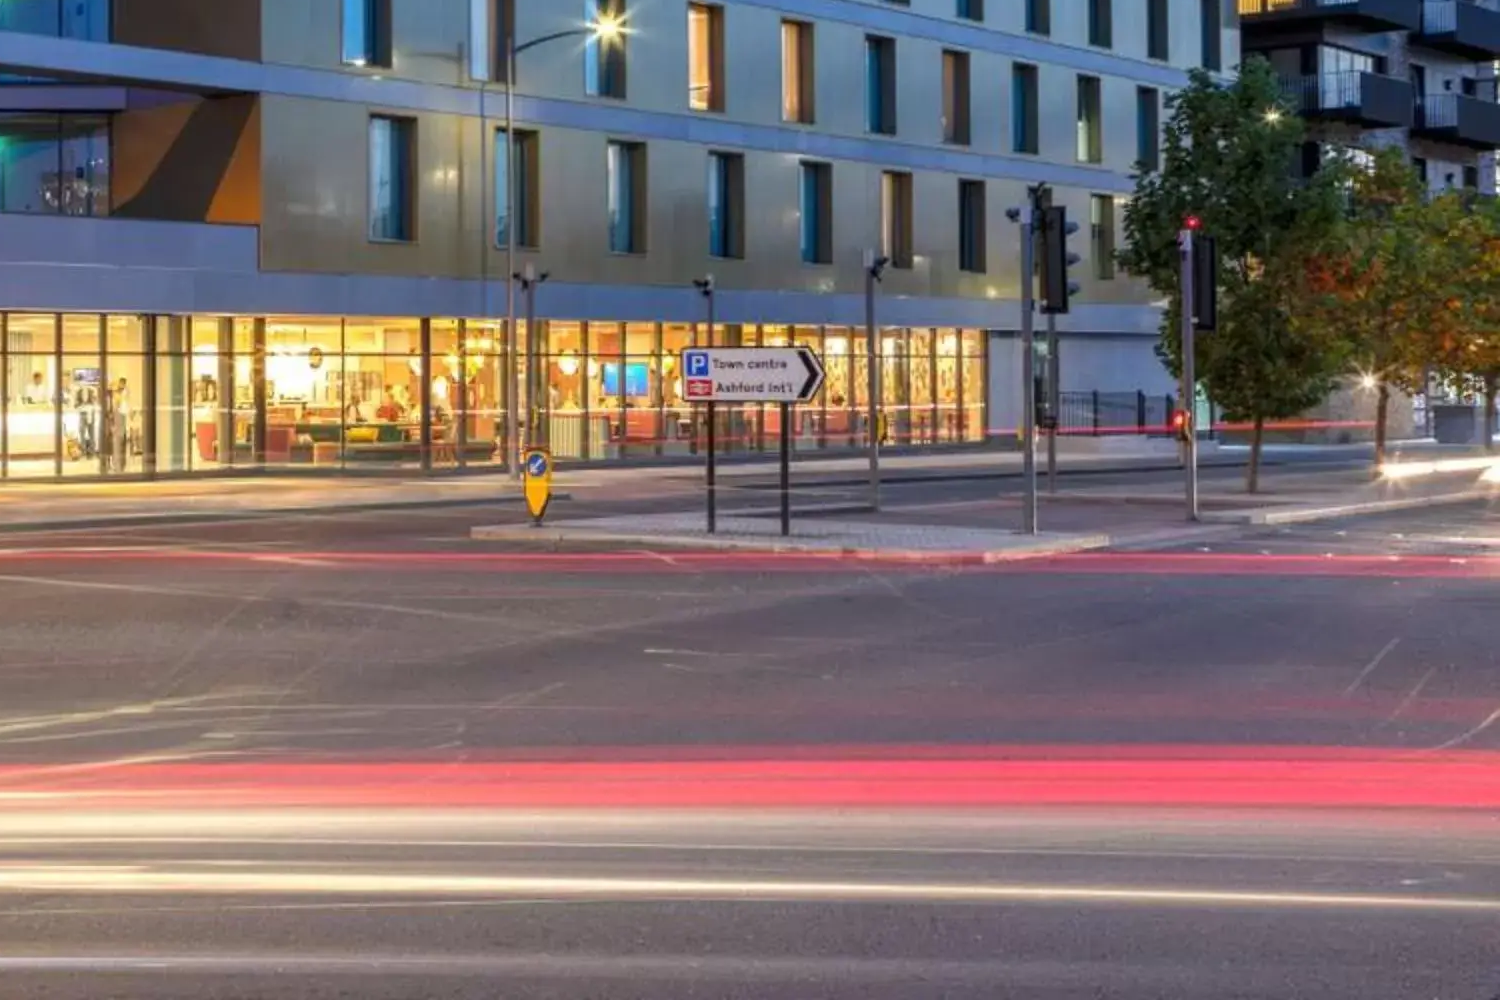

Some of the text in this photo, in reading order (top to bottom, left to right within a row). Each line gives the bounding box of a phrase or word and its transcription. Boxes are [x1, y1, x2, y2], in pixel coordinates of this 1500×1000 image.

[690, 355, 705, 375] P
[712, 358, 787, 370] Town centre
[715, 379, 764, 392] Ashford
